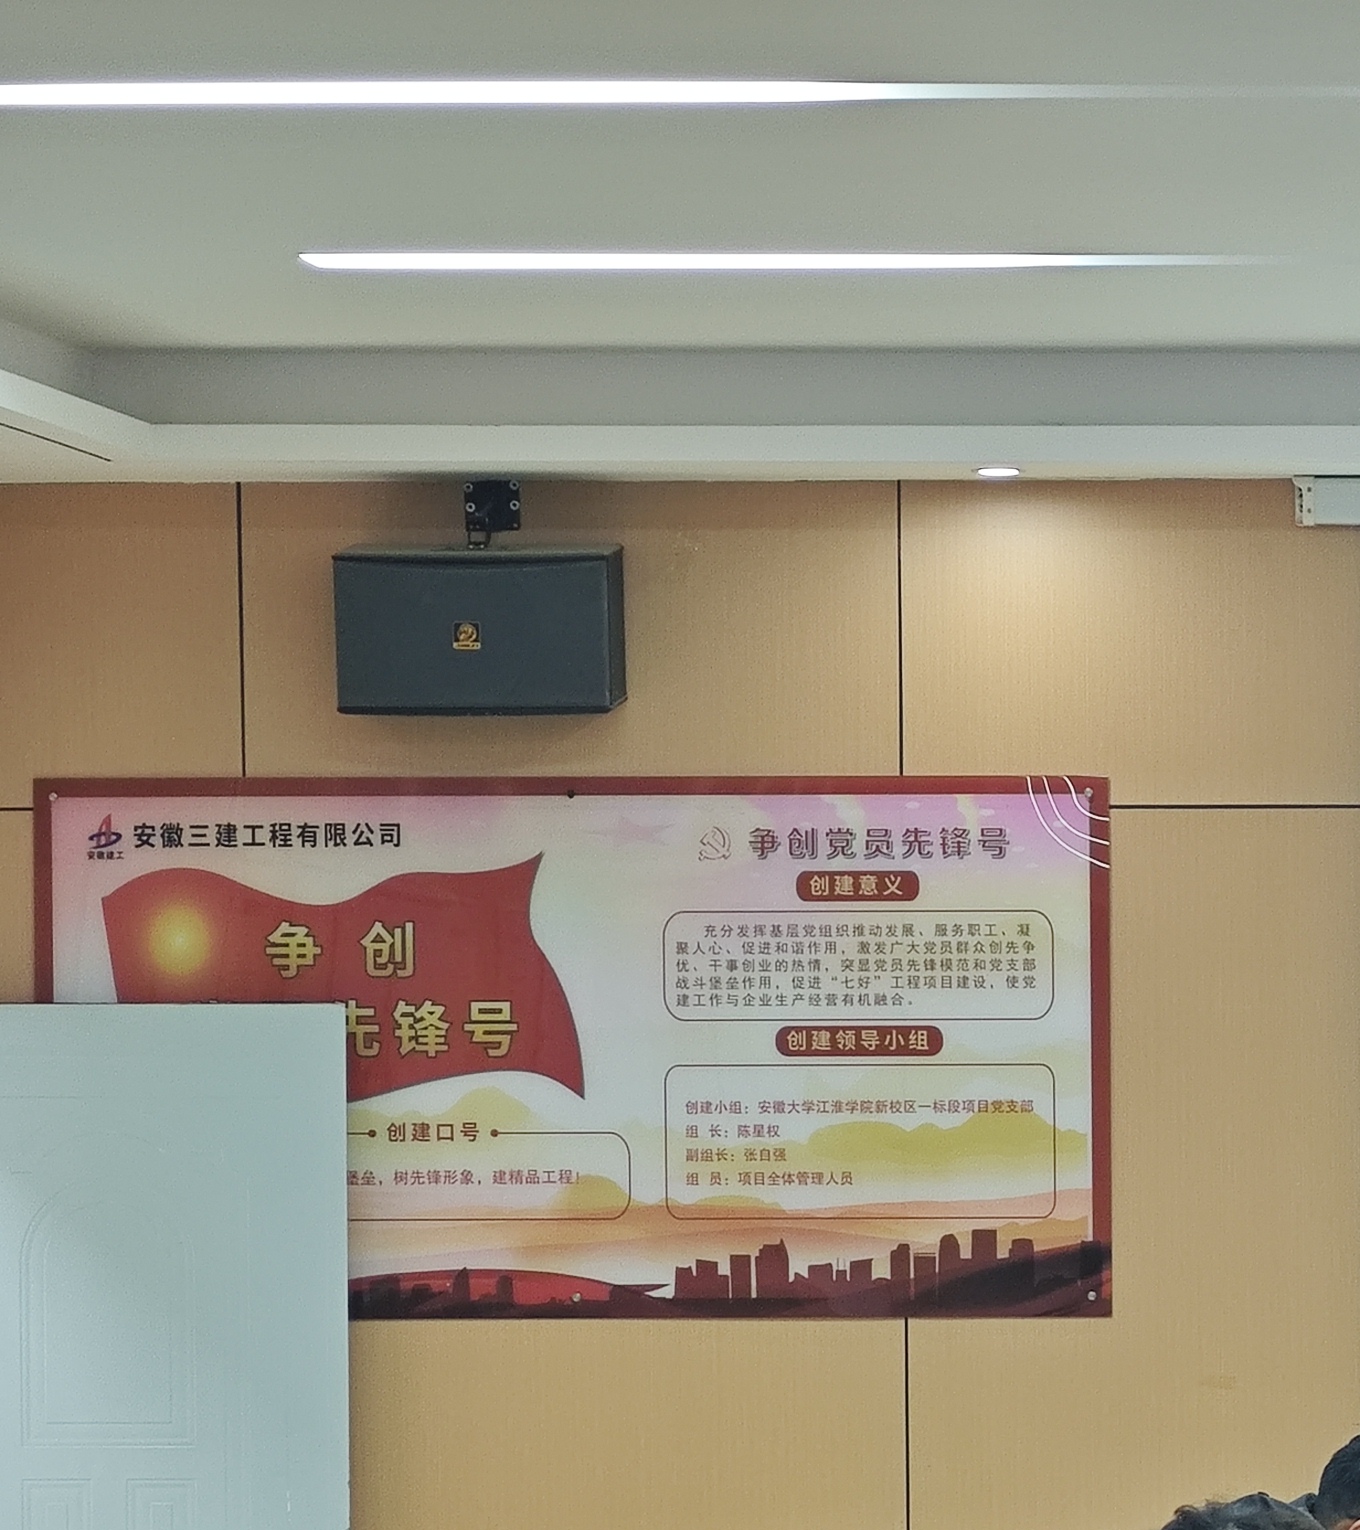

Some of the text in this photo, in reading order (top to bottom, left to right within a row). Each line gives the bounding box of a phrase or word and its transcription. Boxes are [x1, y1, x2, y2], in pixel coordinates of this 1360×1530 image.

[132, 822, 402, 849] 安徽三建工程有限公司
[748, 826, 1011, 862] 争创党员先锋号
[808, 874, 903, 897] 创建意义
[704, 923, 1032, 938] 充分发挥基层党组织推动发展、服务职工、凝
[264, 920, 417, 980] 争创
[675, 941, 1036, 956] 聚人心、促进和谐作用，激发广大党员群众创先争
[675, 958, 1037, 973] 优、干事创业的热情，突显党员先锋模范和党支部
[675, 993, 913, 1008] 建工作与企业生产经营有机融合。
[786, 1029, 930, 1052] 创建领导小组
[386, 1121, 480, 1143] 创建口号
[684, 1147, 787, 1163] 副组长：张自强
